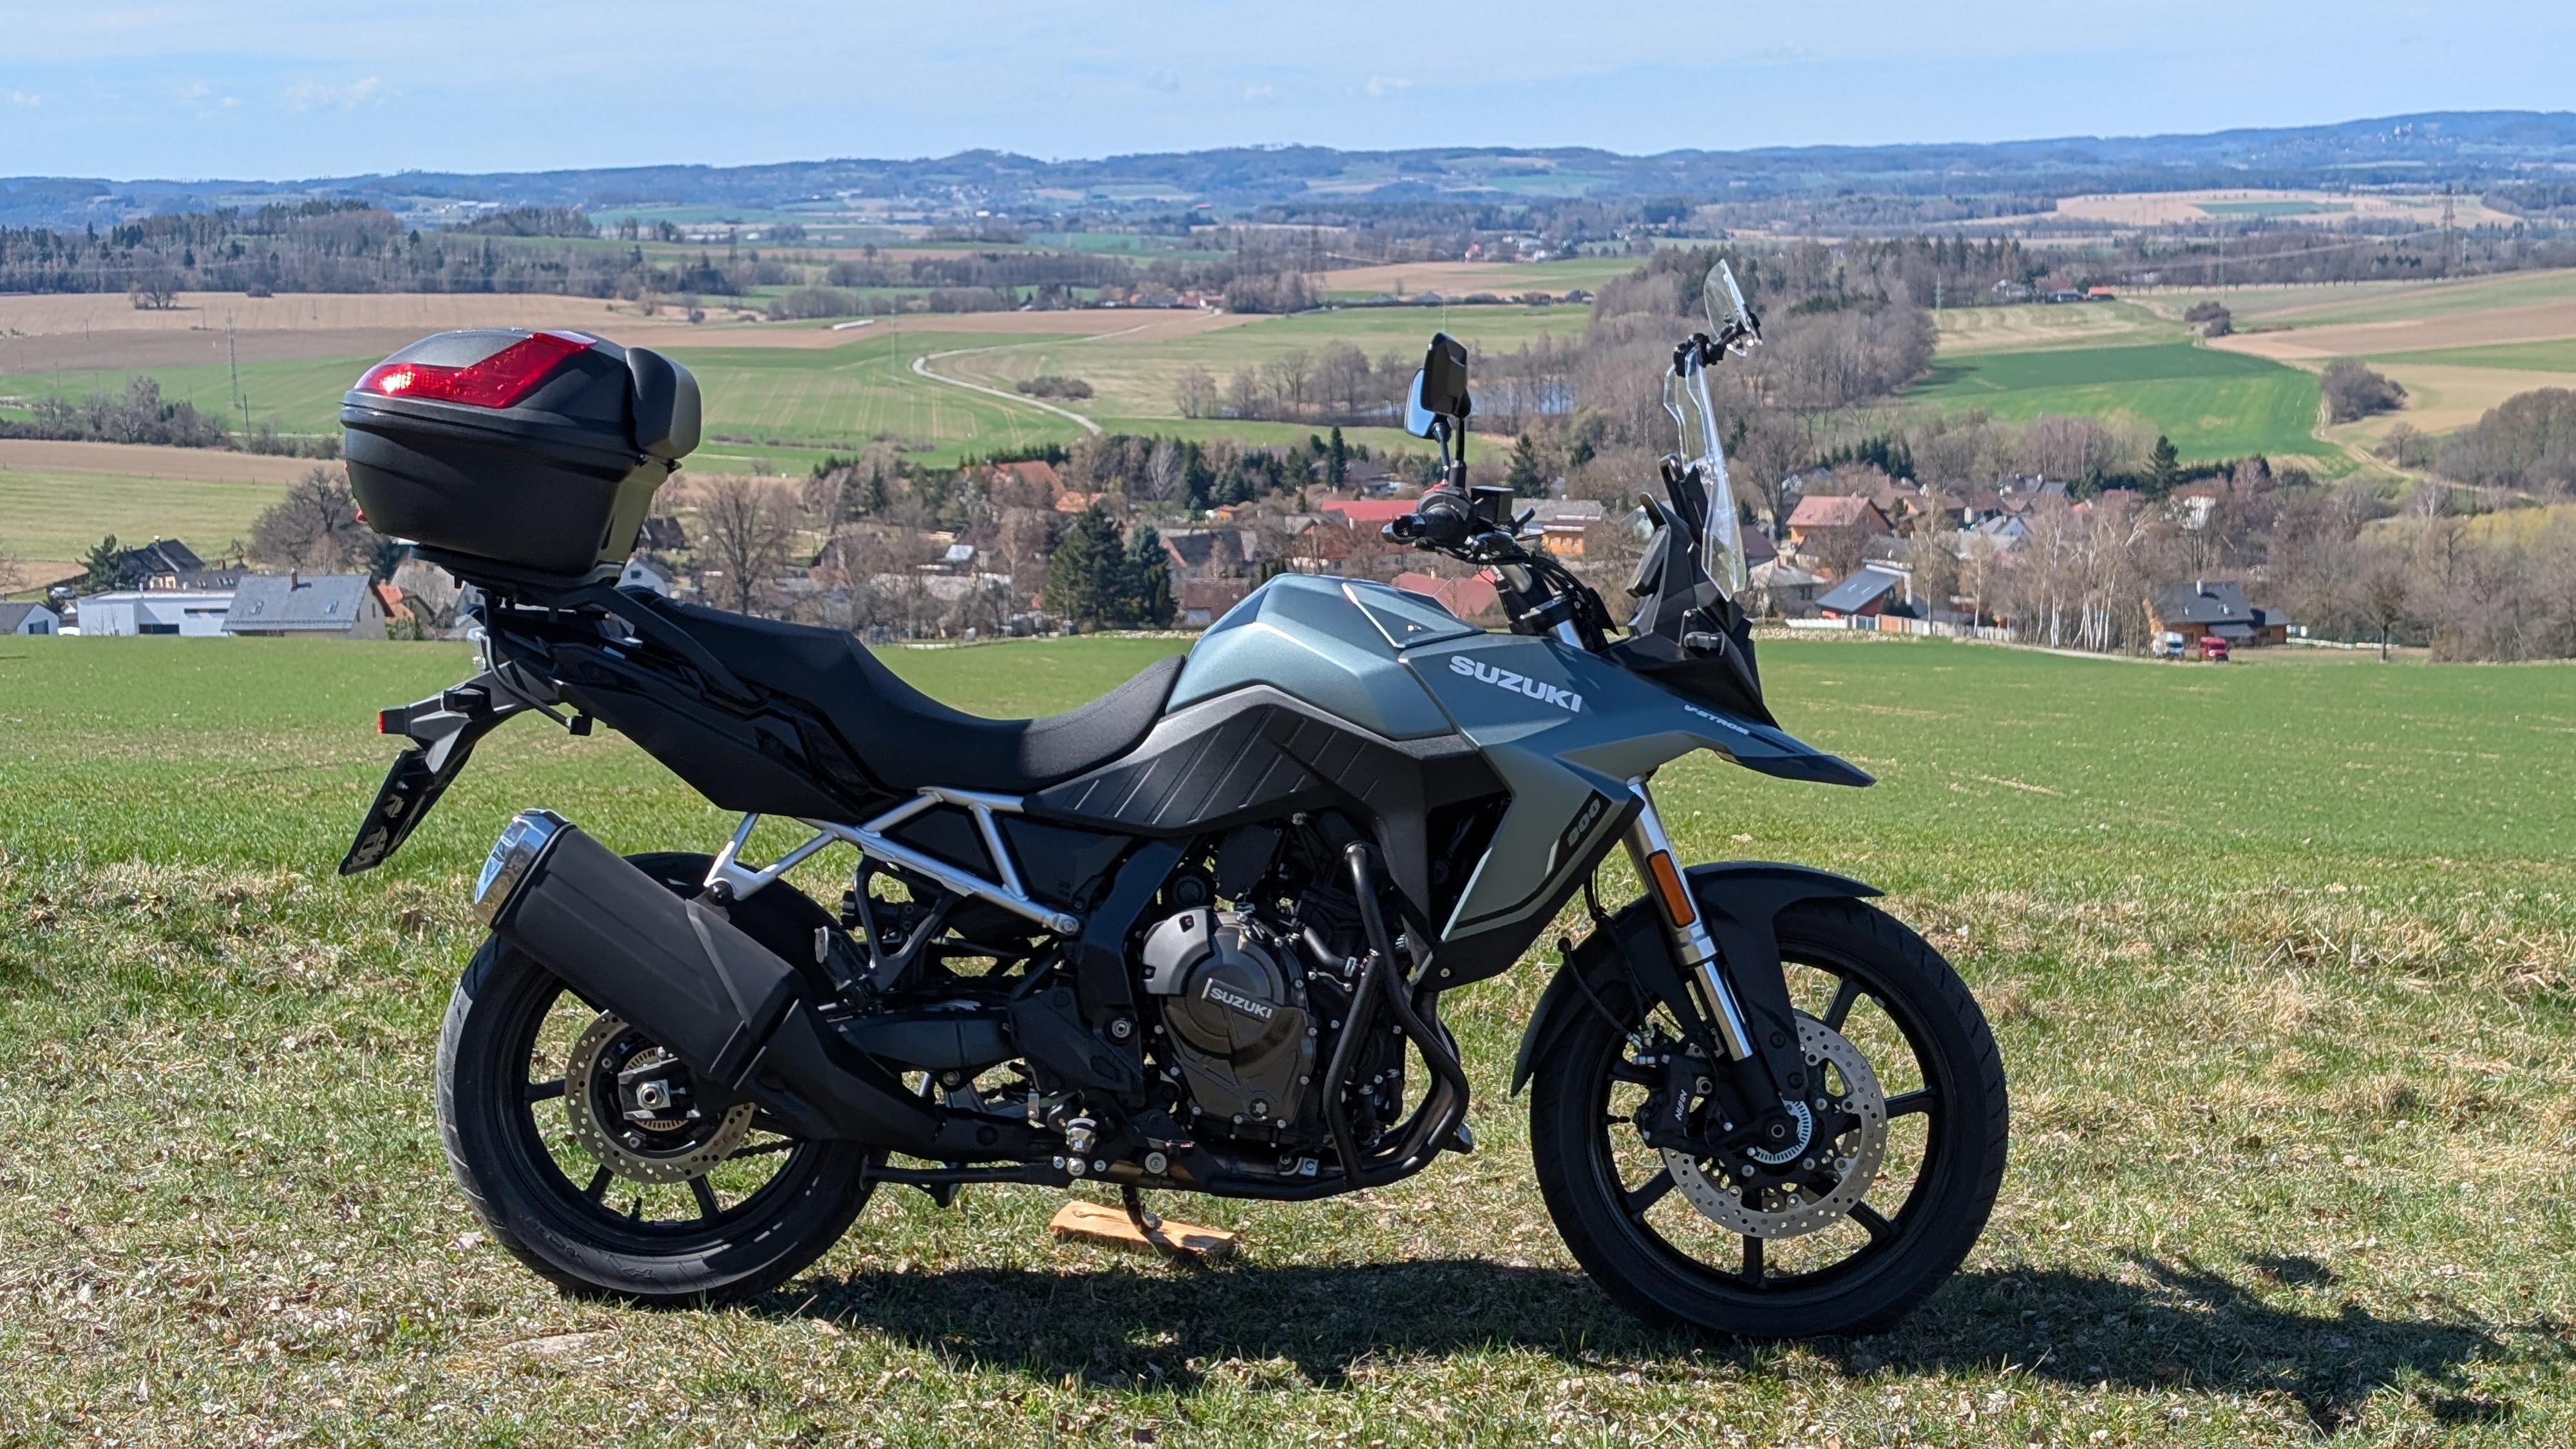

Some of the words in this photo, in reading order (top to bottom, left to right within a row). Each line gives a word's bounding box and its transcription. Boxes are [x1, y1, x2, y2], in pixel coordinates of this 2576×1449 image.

[1449, 656, 1582, 713] SUZUKI
[1567, 799, 1601, 847] 800
[1210, 988, 1273, 1018] SUZUKI
